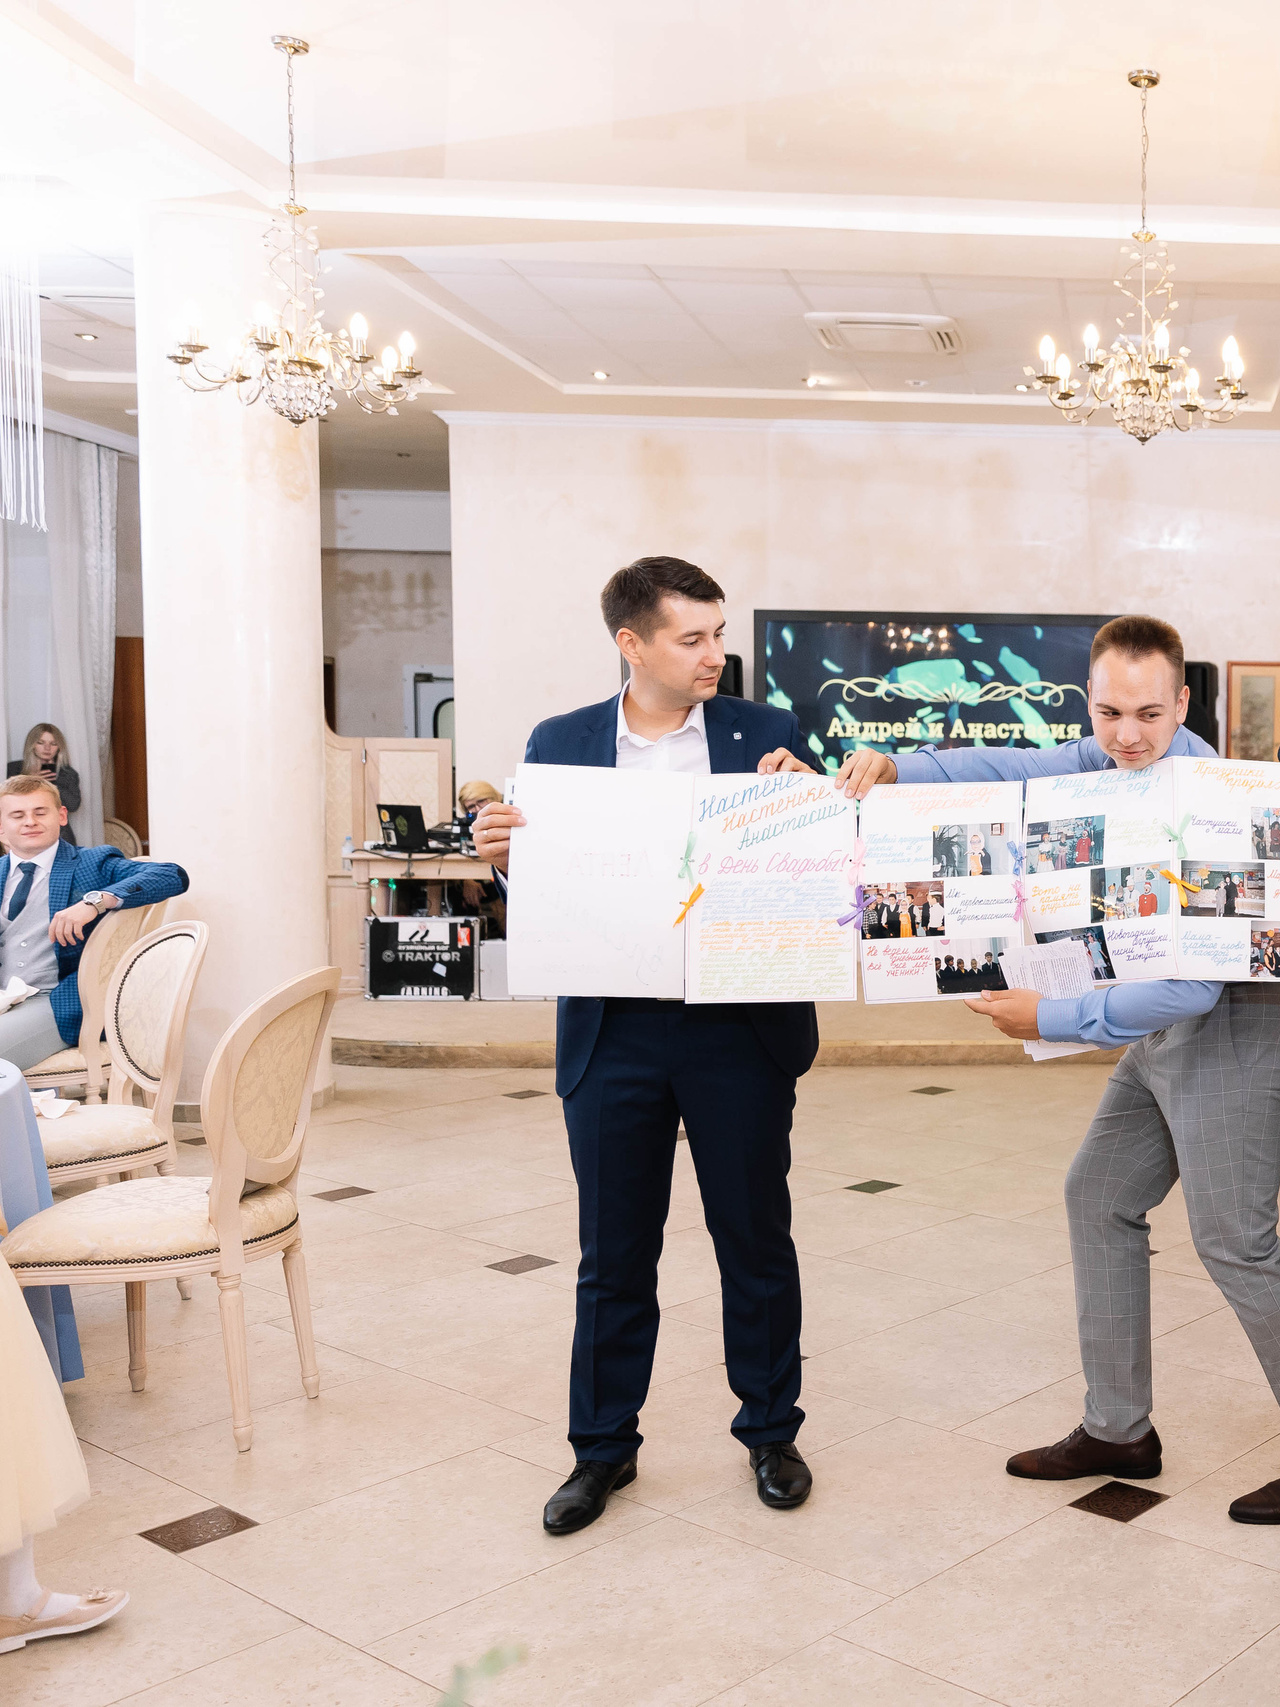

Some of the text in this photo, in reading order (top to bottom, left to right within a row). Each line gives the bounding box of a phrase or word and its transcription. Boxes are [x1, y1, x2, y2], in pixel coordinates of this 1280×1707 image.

[827, 717, 1083, 743] Андрей и Анастасия
[1192, 760, 1266, 781] Праздники
[1052, 776, 1087, 791] Наш
[737, 803, 848, 851] Анастасии
[1191, 814, 1238, 830] Частушки
[1214, 827, 1244, 836] маме
[717, 854, 760, 875] День
[765, 849, 850, 881] Свадьбы!
[1107, 928, 1156, 942] Новогодние
[1180, 931, 1212, 941] Мама
[866, 945, 879, 956] Не
[912, 947, 930, 955] мы
[1111, 947, 1135, 956] песни
[1220, 941, 1245, 950] слово
[398, 951, 461, 961] TRAKTOR
